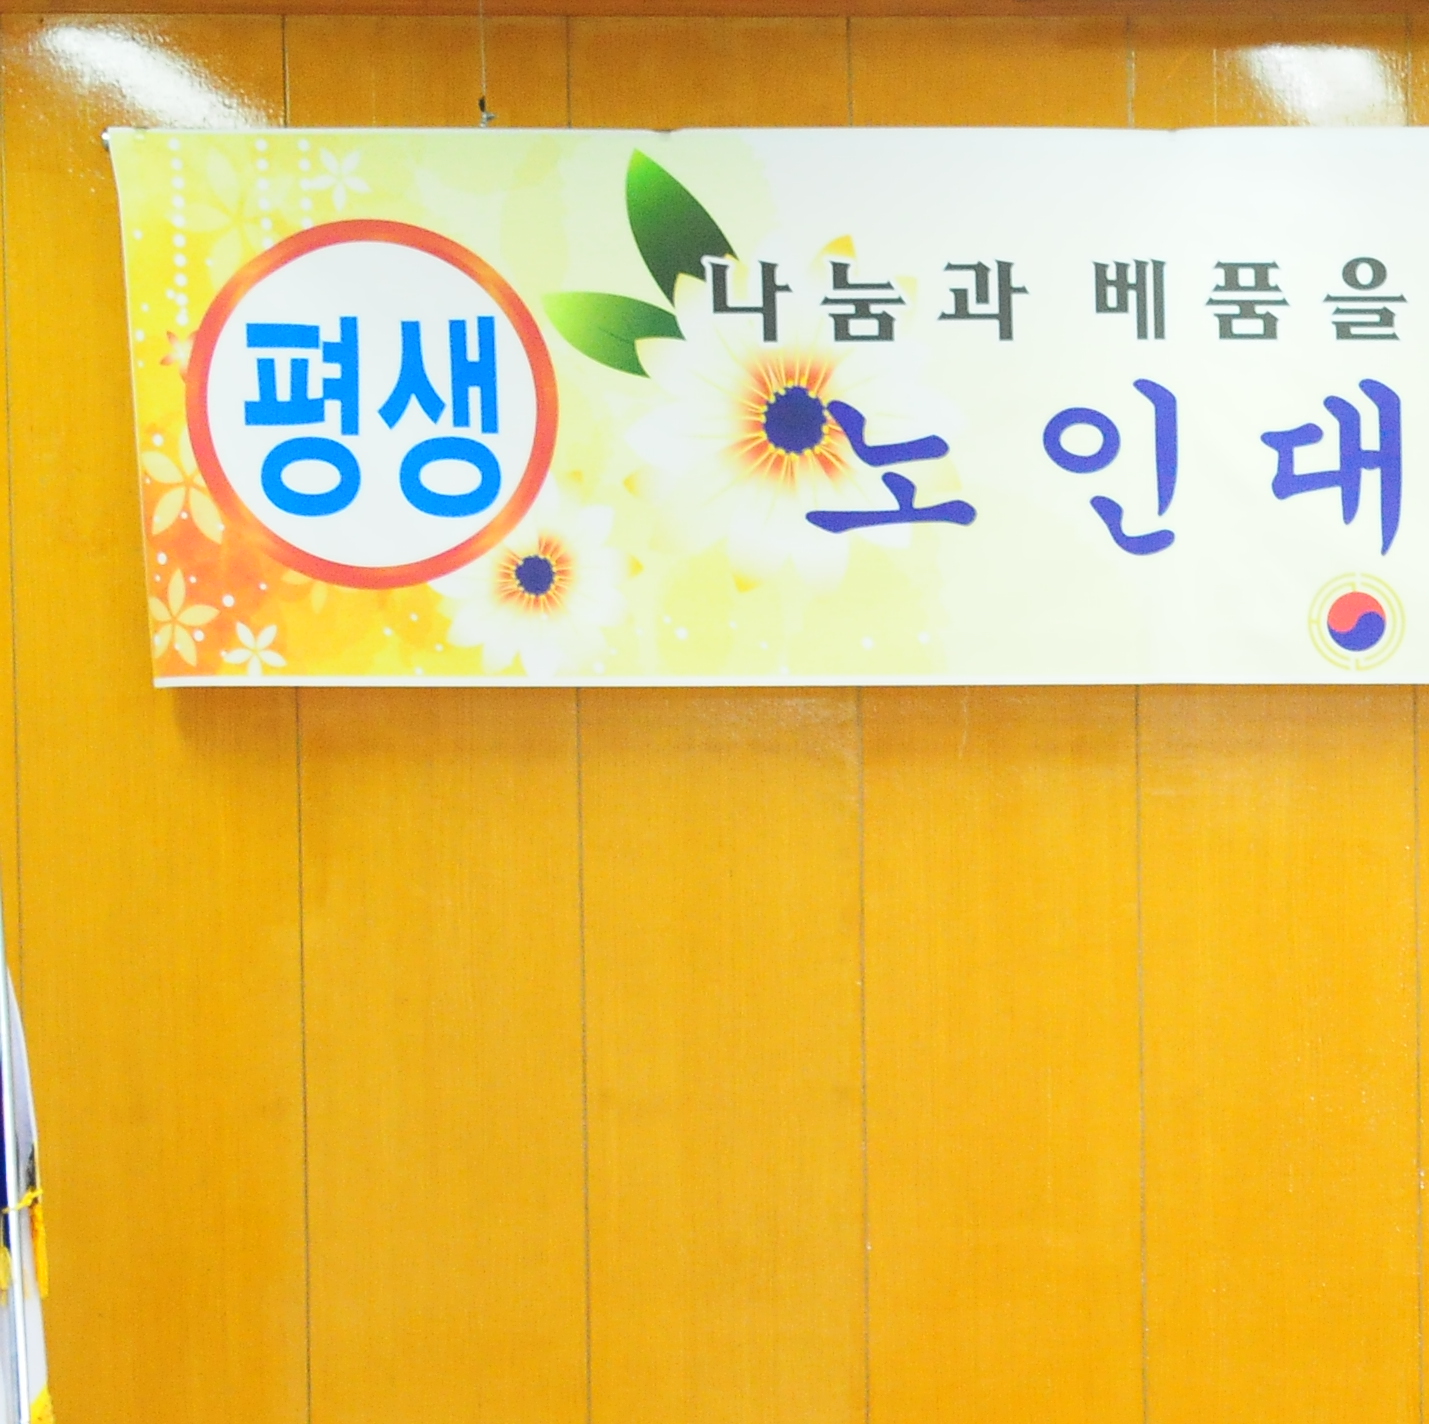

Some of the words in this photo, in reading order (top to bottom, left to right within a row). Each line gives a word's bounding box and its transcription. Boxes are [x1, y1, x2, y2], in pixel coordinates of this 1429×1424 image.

[706, 255, 1029, 343] 나눔과
[1091, 256, 1409, 343] 베품을
[243, 315, 502, 518] 평생
